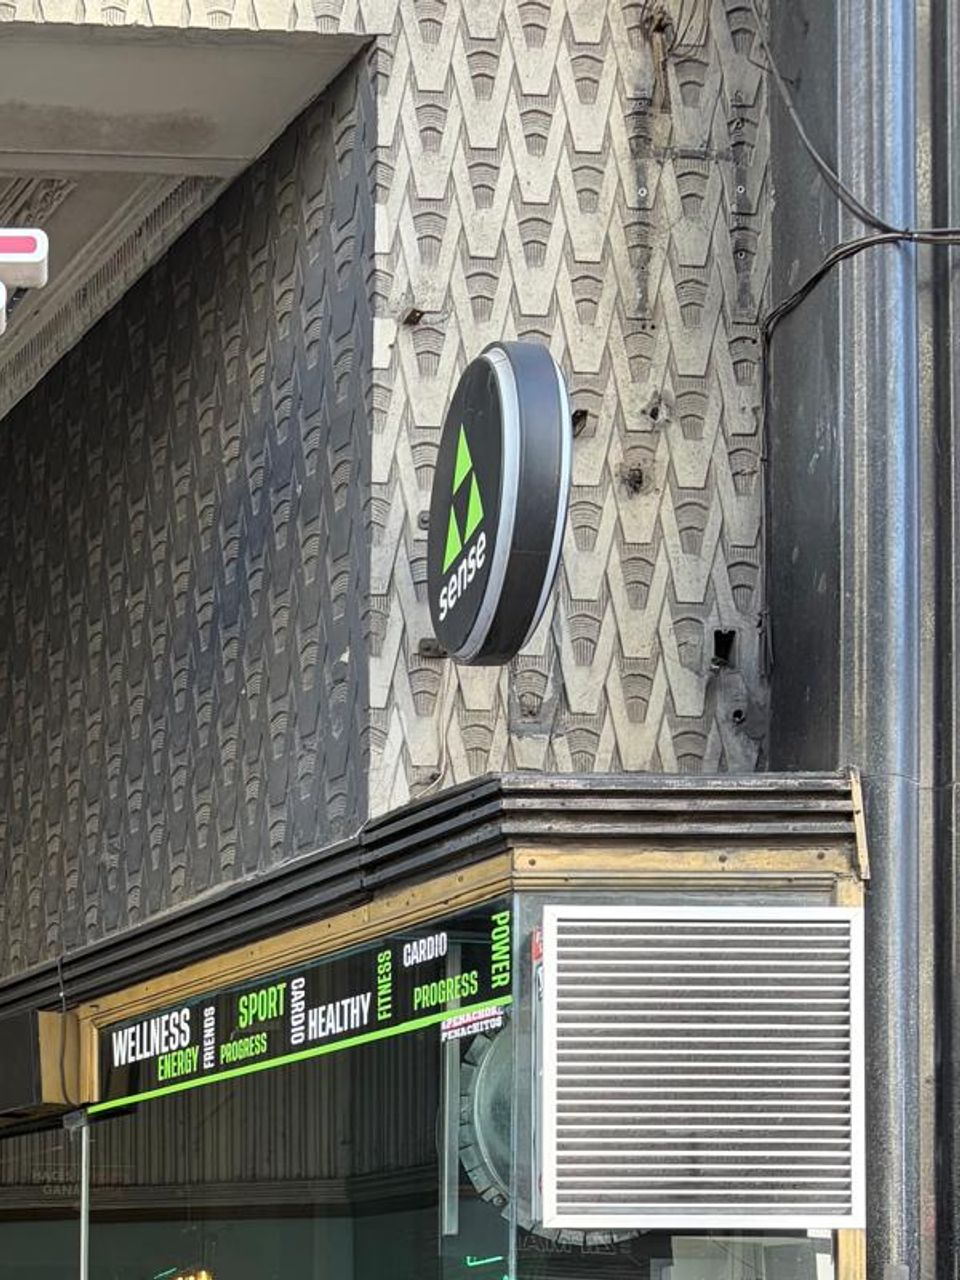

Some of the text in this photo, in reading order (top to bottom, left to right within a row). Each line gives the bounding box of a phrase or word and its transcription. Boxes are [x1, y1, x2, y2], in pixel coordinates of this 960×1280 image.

[439, 531, 486, 621] sense
[403, 932, 447, 967] CARDIO
[491, 910, 511, 989] POWER
[238, 982, 287, 1029] SPORT
[290, 977, 306, 1045] CARDIO
[377, 950, 392, 1021] FITNESS
[414, 970, 478, 1011] PROGRESS
[112, 1008, 190, 1067] WELLNESS
[203, 1006, 216, 1069] FRIENDS
[308, 992, 372, 1040] HEALTHY
[158, 1045, 200, 1081] ENERGY
[219, 1032, 268, 1065] PROGRESS
